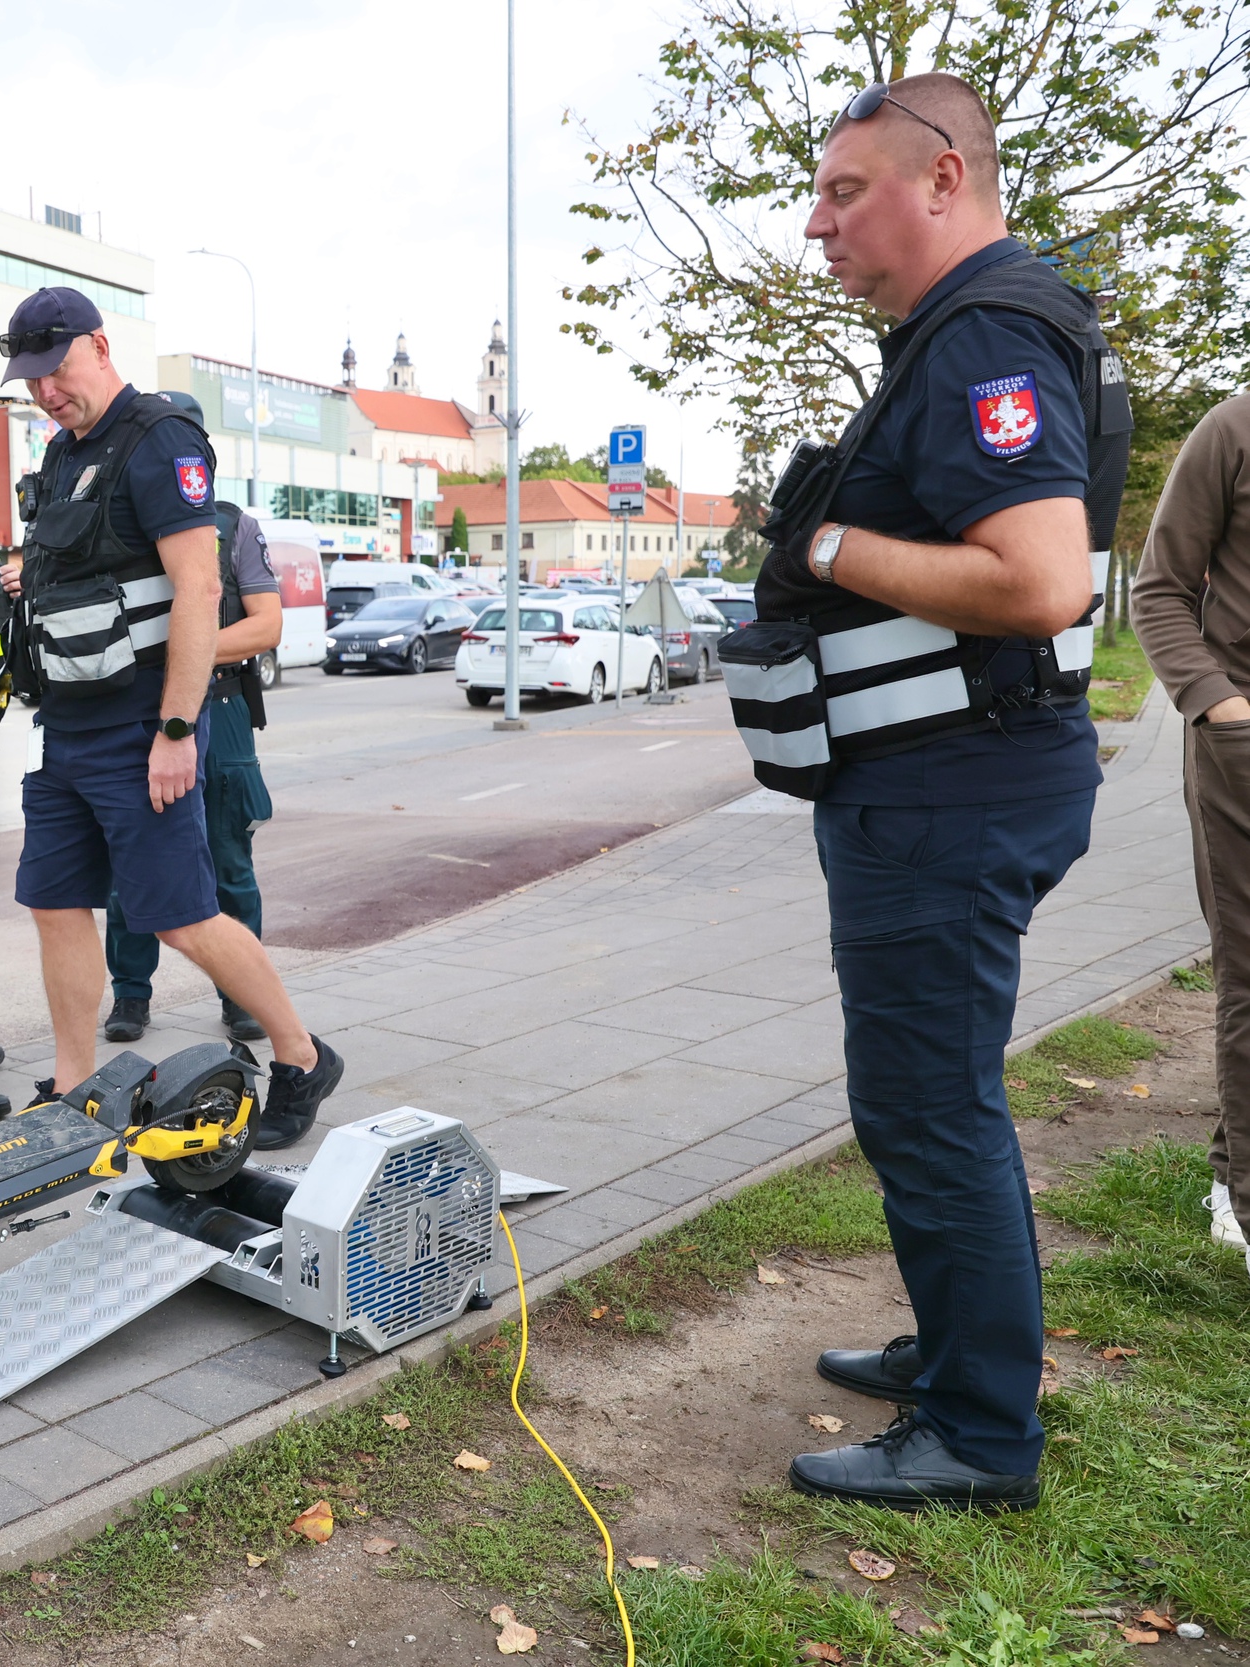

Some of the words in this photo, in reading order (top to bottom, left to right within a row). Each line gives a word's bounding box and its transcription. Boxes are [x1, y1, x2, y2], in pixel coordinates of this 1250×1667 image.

[974, 374, 1028, 392] VIEŠOSIOS
[978, 381, 1025, 396] TVARKOS
[618, 433, 638, 463] P
[995, 440, 1032, 455] VILNIUS
[47, 1172, 80, 1189] MINI
